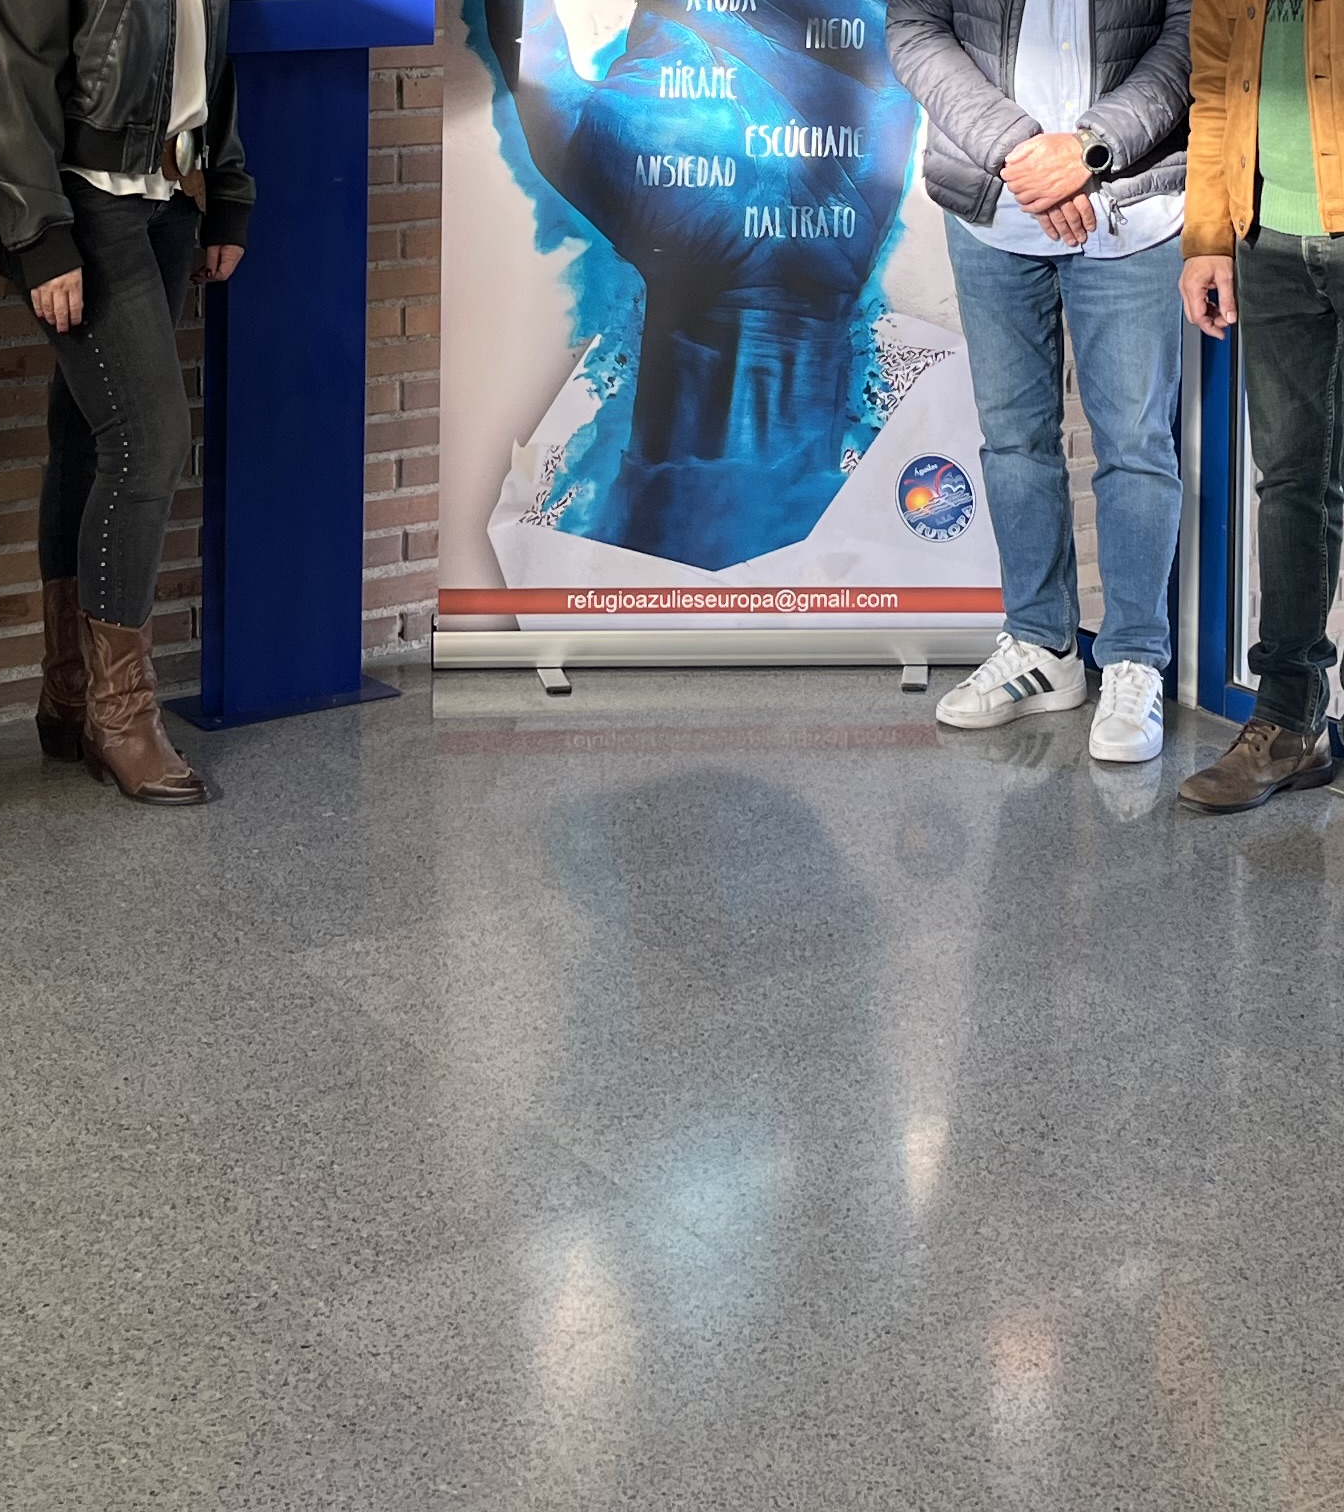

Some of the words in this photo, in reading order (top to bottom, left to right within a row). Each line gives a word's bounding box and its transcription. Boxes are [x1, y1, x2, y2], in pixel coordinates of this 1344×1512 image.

[806, 17, 865, 50] MIEDO
[659, 59, 738, 100] MÍRAME
[745, 119, 867, 158] ESCÚCHAME
[634, 154, 737, 188] ANSIEDAD
[744, 205, 856, 239] MALTRATO
[916, 504, 973, 540] EUROPA
[567, 589, 898, 613] refugioazulieseuropa@gmail.com
